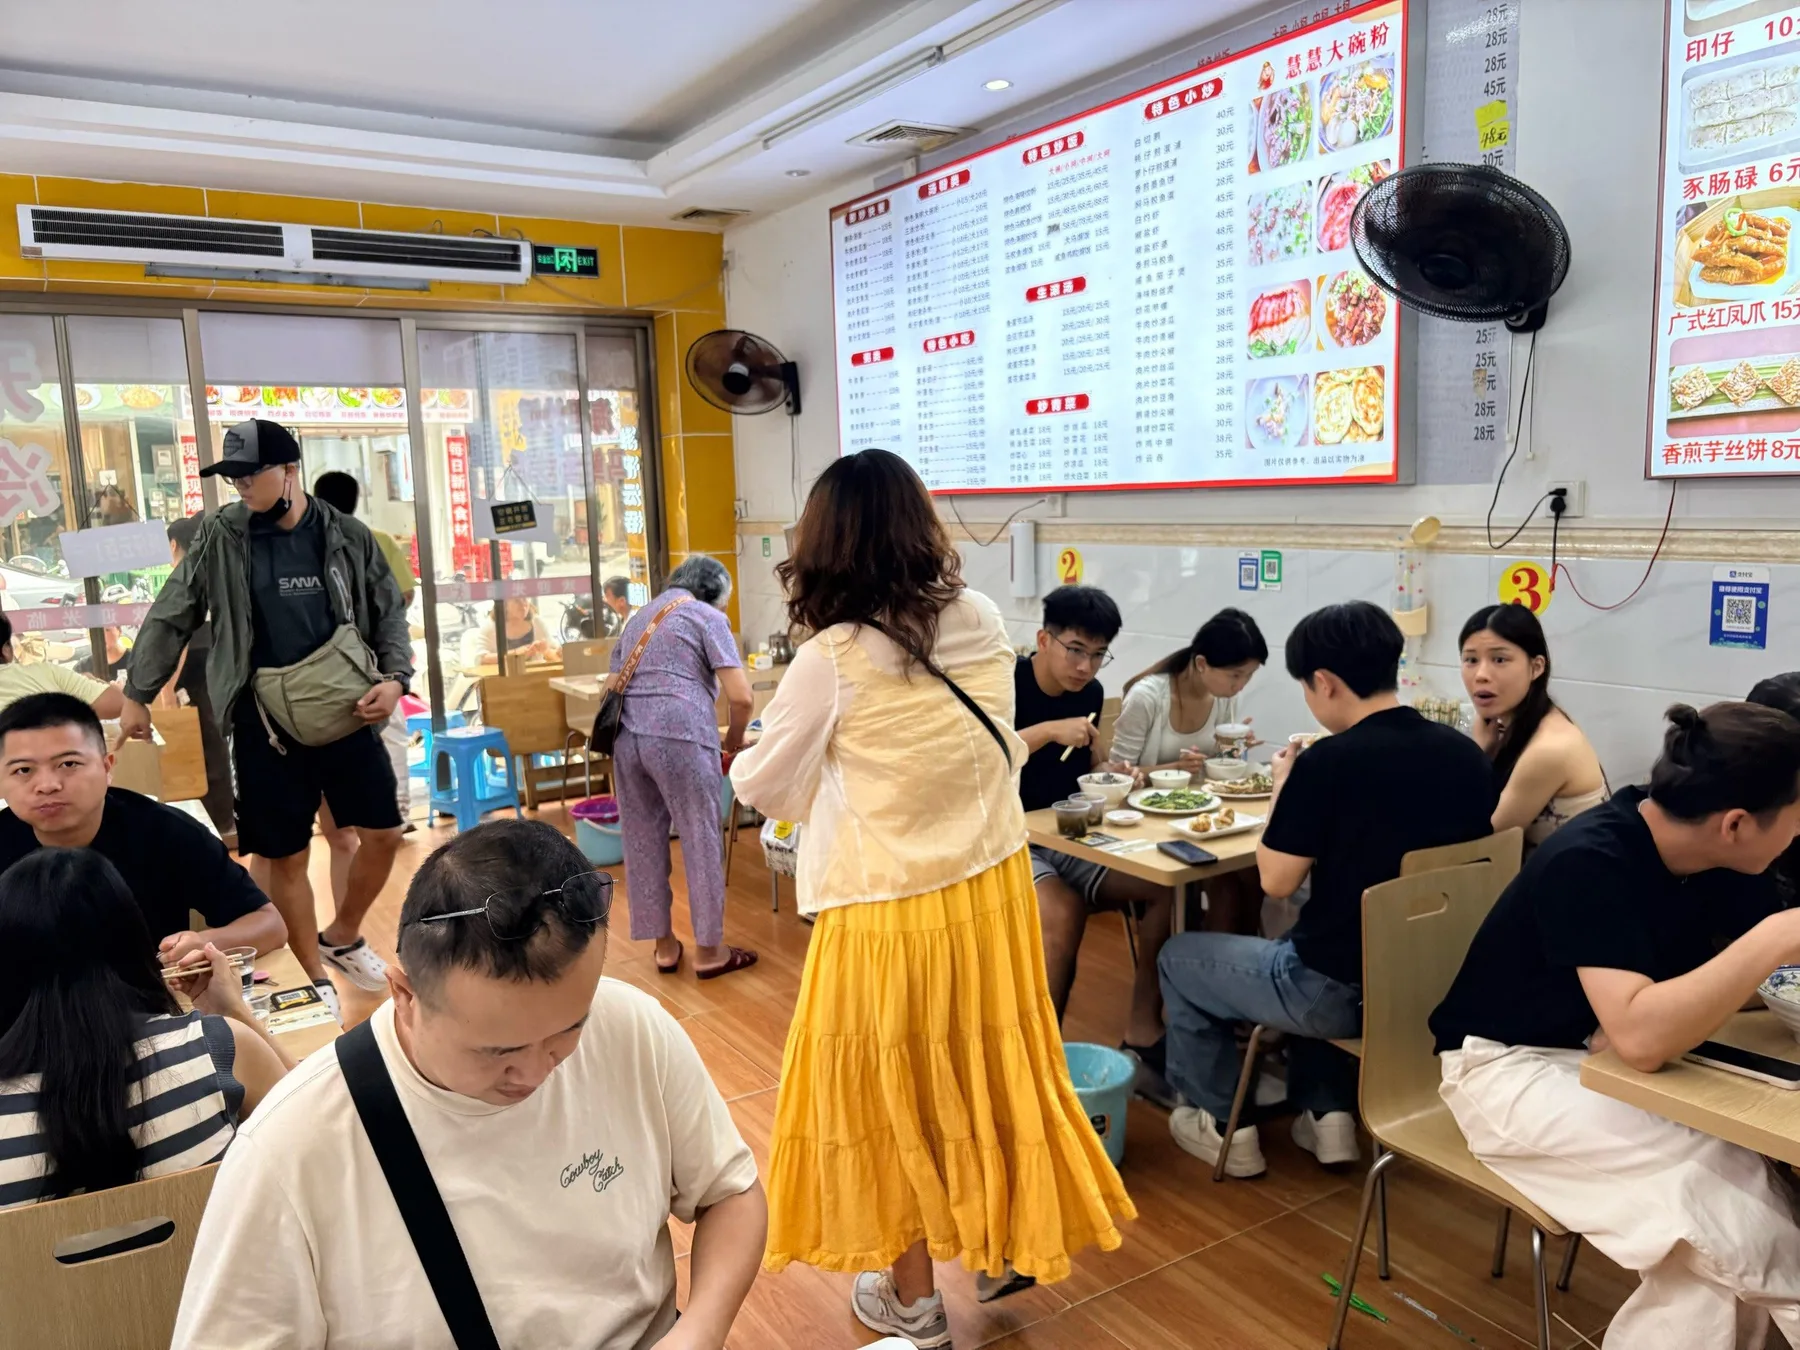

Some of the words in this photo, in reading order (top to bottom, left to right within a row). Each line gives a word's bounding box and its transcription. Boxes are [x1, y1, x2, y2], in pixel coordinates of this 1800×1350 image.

[1485, 28, 1507, 48] 28元
[1286, 22, 1389, 79] 慧慧大碗粉
[1685, 31, 1735, 62] 印仔
[1484, 53, 1506, 73] 28元
[1483, 77, 1505, 96] 45元
[1151, 82, 1214, 116] 特色小炒
[1215, 107, 1234, 120] 40元
[1215, 124, 1234, 137] 30元
[1027, 133, 1077, 162] 特色炒饭
[1215, 141, 1234, 154] 30元
[1215, 158, 1234, 171] 28元
[1769, 158, 1800, 183] 6元
[1215, 174, 1234, 187] 28元
[1215, 191, 1234, 203] 45元
[1216, 240, 1233, 253] 45元
[577, 256, 595, 267] EXIT
[1216, 256, 1233, 269] 35元
[1216, 272, 1233, 285] 35元
[1216, 288, 1233, 301] 38元
[1216, 305, 1233, 317] 38元
[1668, 301, 1766, 336] 广式红凤爪
[1216, 321, 1233, 333] 38元
[926, 333, 970, 351] 特色小吃
[1216, 337, 1233, 349] 38元
[1215, 354, 1232, 365] 28元
[1476, 352, 1496, 367] 25元
[1215, 370, 1232, 380] 28元
[1215, 386, 1232, 396] 28元
[1037, 397, 1075, 412] 炒青菜
[1215, 402, 1232, 412] 30元
[1474, 401, 1495, 417] 28元
[1093, 420, 1108, 429] 18元
[1215, 418, 1232, 428] 30元
[1093, 433, 1108, 442] 18元
[1215, 434, 1232, 443] 38元
[1473, 425, 1495, 440] 28元
[1093, 446, 1108, 455] 18元
[1215, 450, 1232, 459] 35元
[1662, 438, 1768, 465] 香煎芋丝饼
[1771, 438, 1800, 460] 8元
[1093, 458, 1108, 467] 18元
[1093, 470, 1108, 479] 18元
[450, 441, 470, 536] 每日新鲜食材
[1062, 552, 1078, 582] 2
[1512, 568, 1541, 612] 3
[560, 1149, 603, 1188] Cowboy
